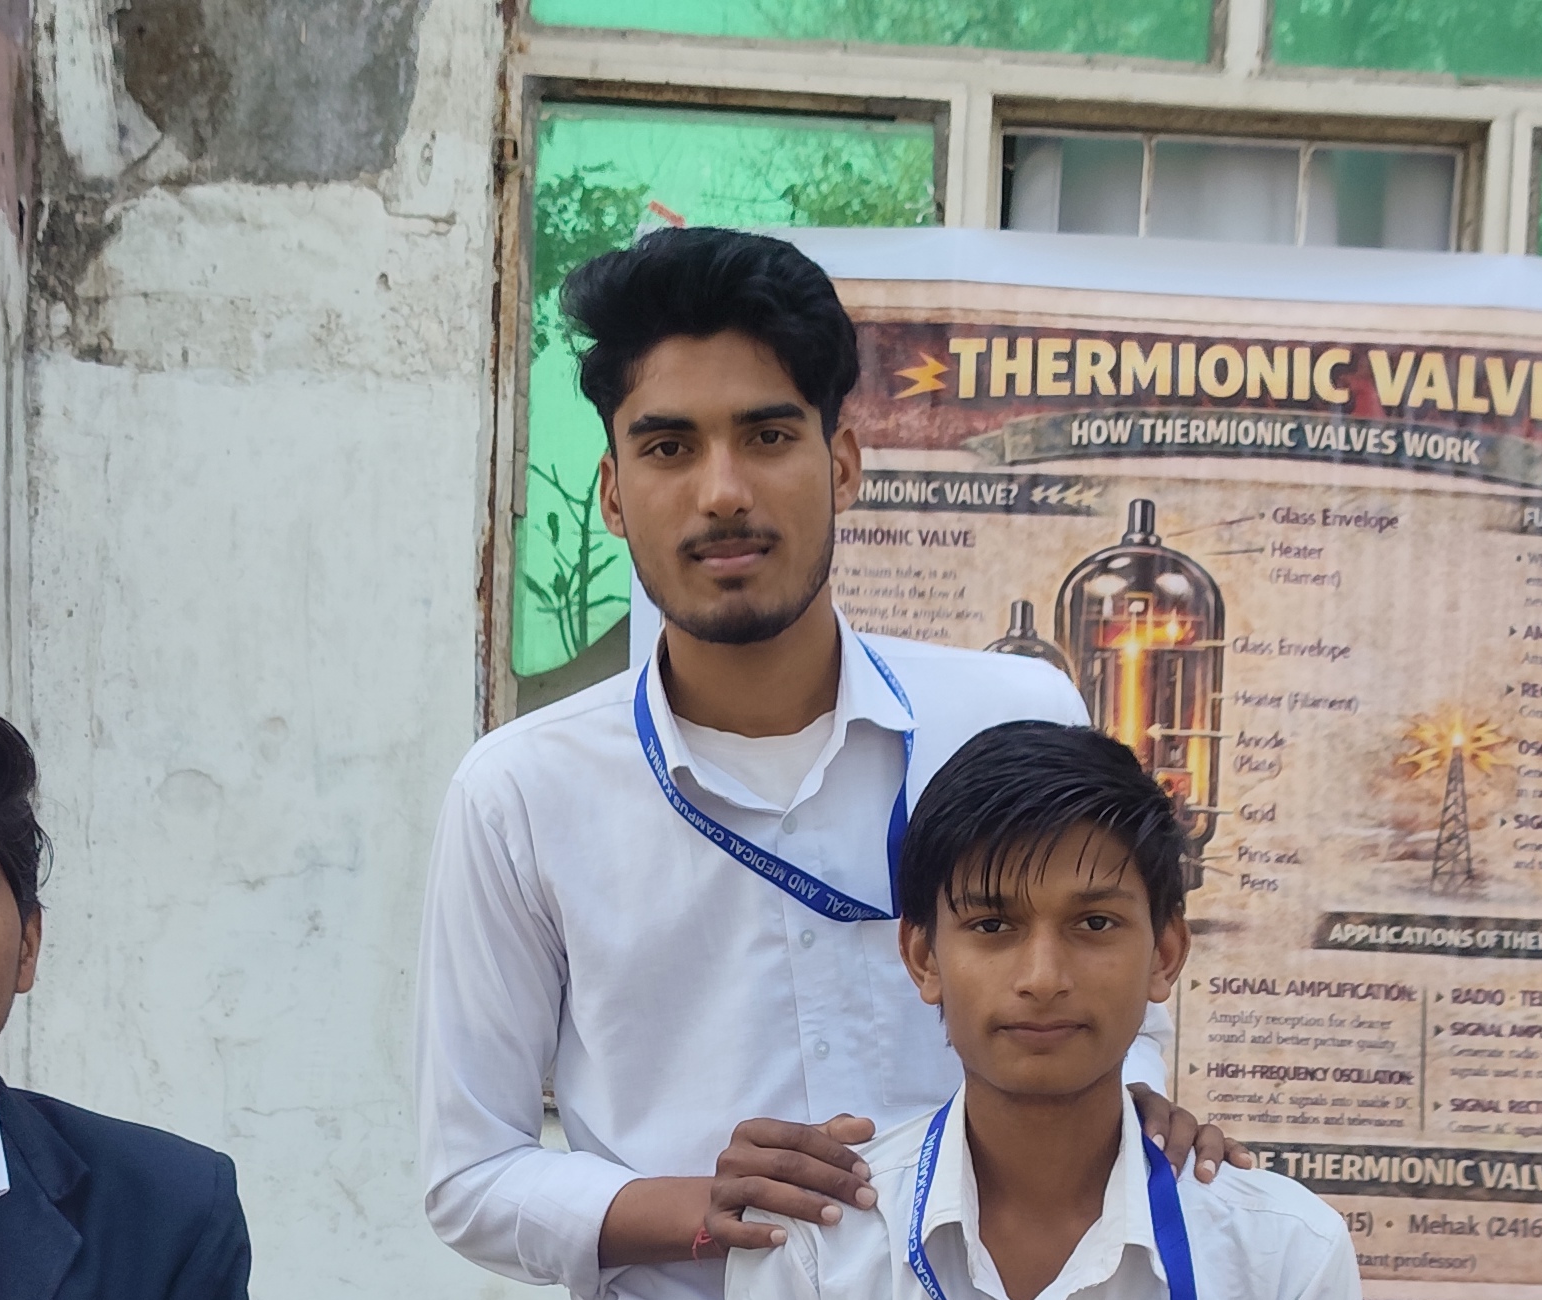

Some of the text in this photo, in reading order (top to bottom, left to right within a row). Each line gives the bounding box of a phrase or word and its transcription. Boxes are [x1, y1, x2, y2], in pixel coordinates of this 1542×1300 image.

[947, 337, 1351, 403] THERMIONIC
[1071, 417, 1481, 465] HOW THERMIONIC VALVES WORK
[857, 478, 1019, 506] RMIONIC VALVE?
[1272, 506, 1399, 533] Glass Envelope
[834, 527, 976, 548] ERMIONIC VALVE
[1270, 541, 1324, 560] Heater
[1232, 635, 1351, 662] Glass Envelope
[1240, 803, 1277, 823] Grid
[728, 835, 788, 882] MEDICAL
[1238, 845, 1271, 864] Pins
[787, 873, 821, 901] AND
[1240, 873, 1279, 892] Pens
[1328, 923, 1473, 949] APPLICATIONS
[1477, 929, 1498, 949] OF
[1209, 977, 1418, 1001] SIGNAL AMPLIFICATION:
[1450, 988, 1505, 1006] RADIO
[1208, 1010, 1263, 1028] Amplify
[1265, 1013, 1324, 1029] reception
[1450, 1022, 1505, 1038] SIGNAL
[1208, 1030, 1246, 1045] sound
[1249, 1031, 1273, 1046] and
[1206, 1062, 1416, 1087] HIGH-FREQUENCY OSCILLATION:
[1450, 1098, 1503, 1114] SIGNAL
[1207, 1111, 1244, 1126] power
[1281, 1152, 1476, 1187] THERMIONIC
[1340, 1210, 1374, 1238] 15)
[1408, 1214, 1481, 1237] Mehak
[1394, 1252, 1477, 1274] professor)
